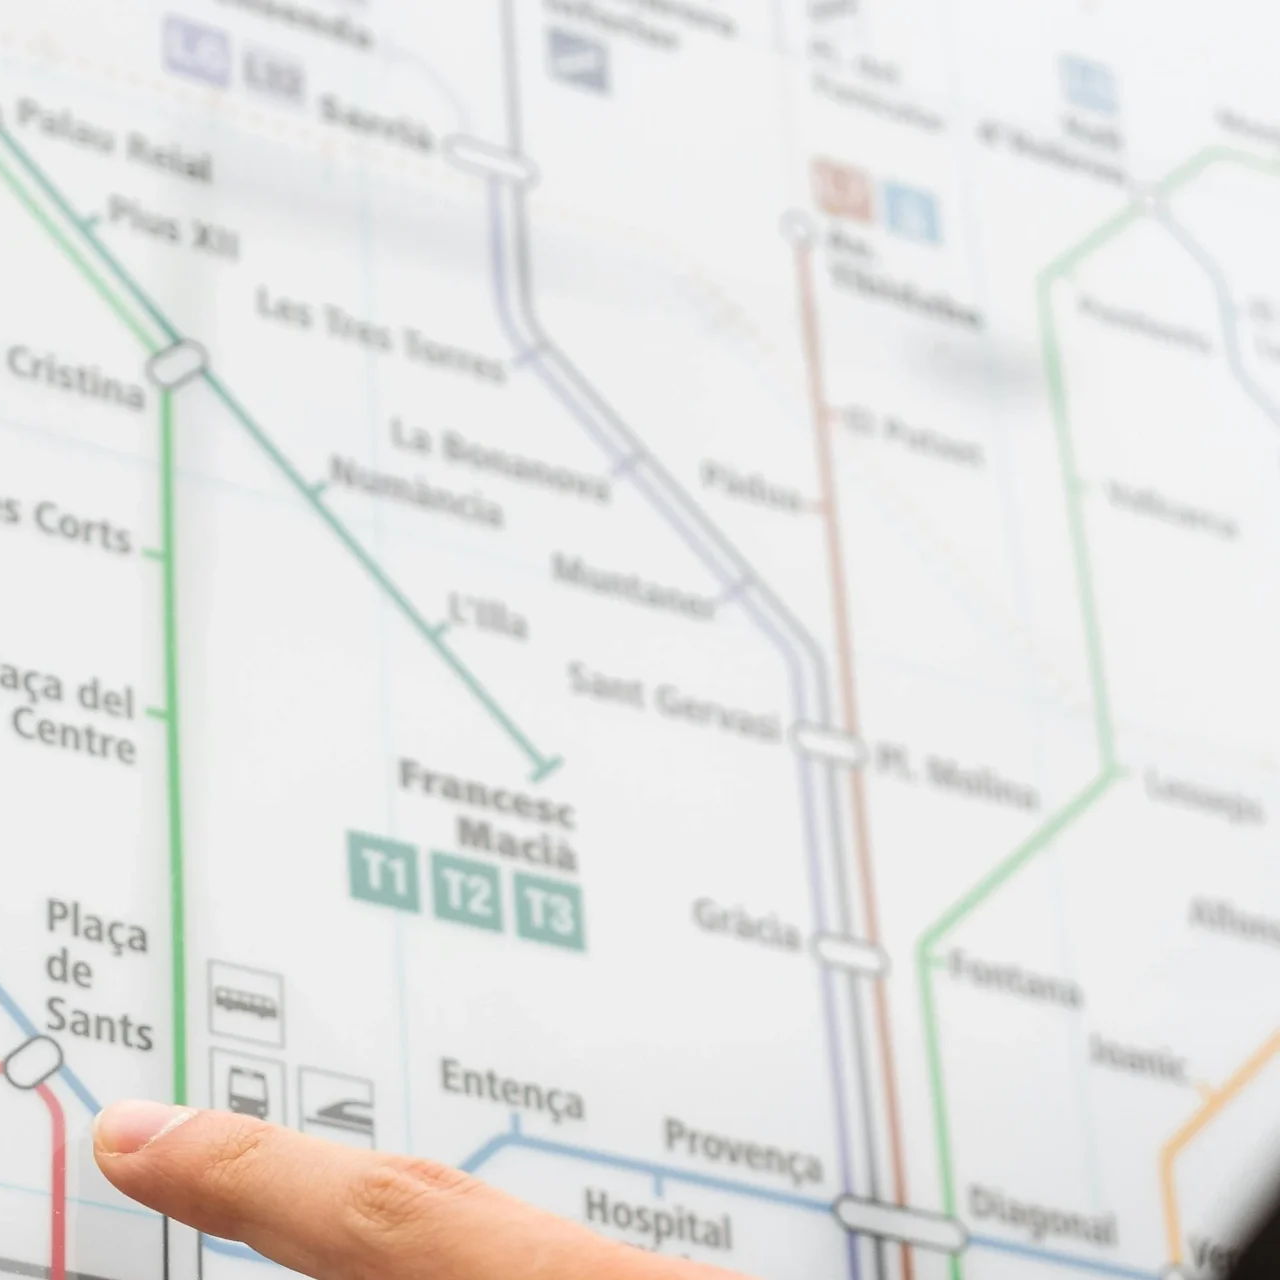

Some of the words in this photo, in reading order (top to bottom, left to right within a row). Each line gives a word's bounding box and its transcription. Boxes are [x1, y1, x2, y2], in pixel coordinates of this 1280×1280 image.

[17, 97, 115, 155] Palau
[108, 193, 181, 246] Pius
[192, 221, 240, 261] XII
[254, 285, 313, 330] Les
[6, 344, 147, 412] Cristina
[390, 416, 433, 455] La
[442, 428, 612, 503] Bonanova
[33, 501, 132, 556] Corts
[76, 679, 135, 721] del
[568, 660, 646, 711] Sant
[11, 706, 137, 765] Centre
[398, 757, 577, 830] Francesc
[455, 815, 578, 872] Macià
[361, 848, 408, 897] T1
[442, 869, 492, 917] T2
[524, 887, 575, 937] T3
[46, 898, 149, 956] Plaça
[46, 948, 93, 988] de
[46, 998, 154, 1051] Sants
[440, 1057, 586, 1125] Entença
[664, 1117, 824, 1186] Provença
[584, 1188, 733, 1252] Hospital
